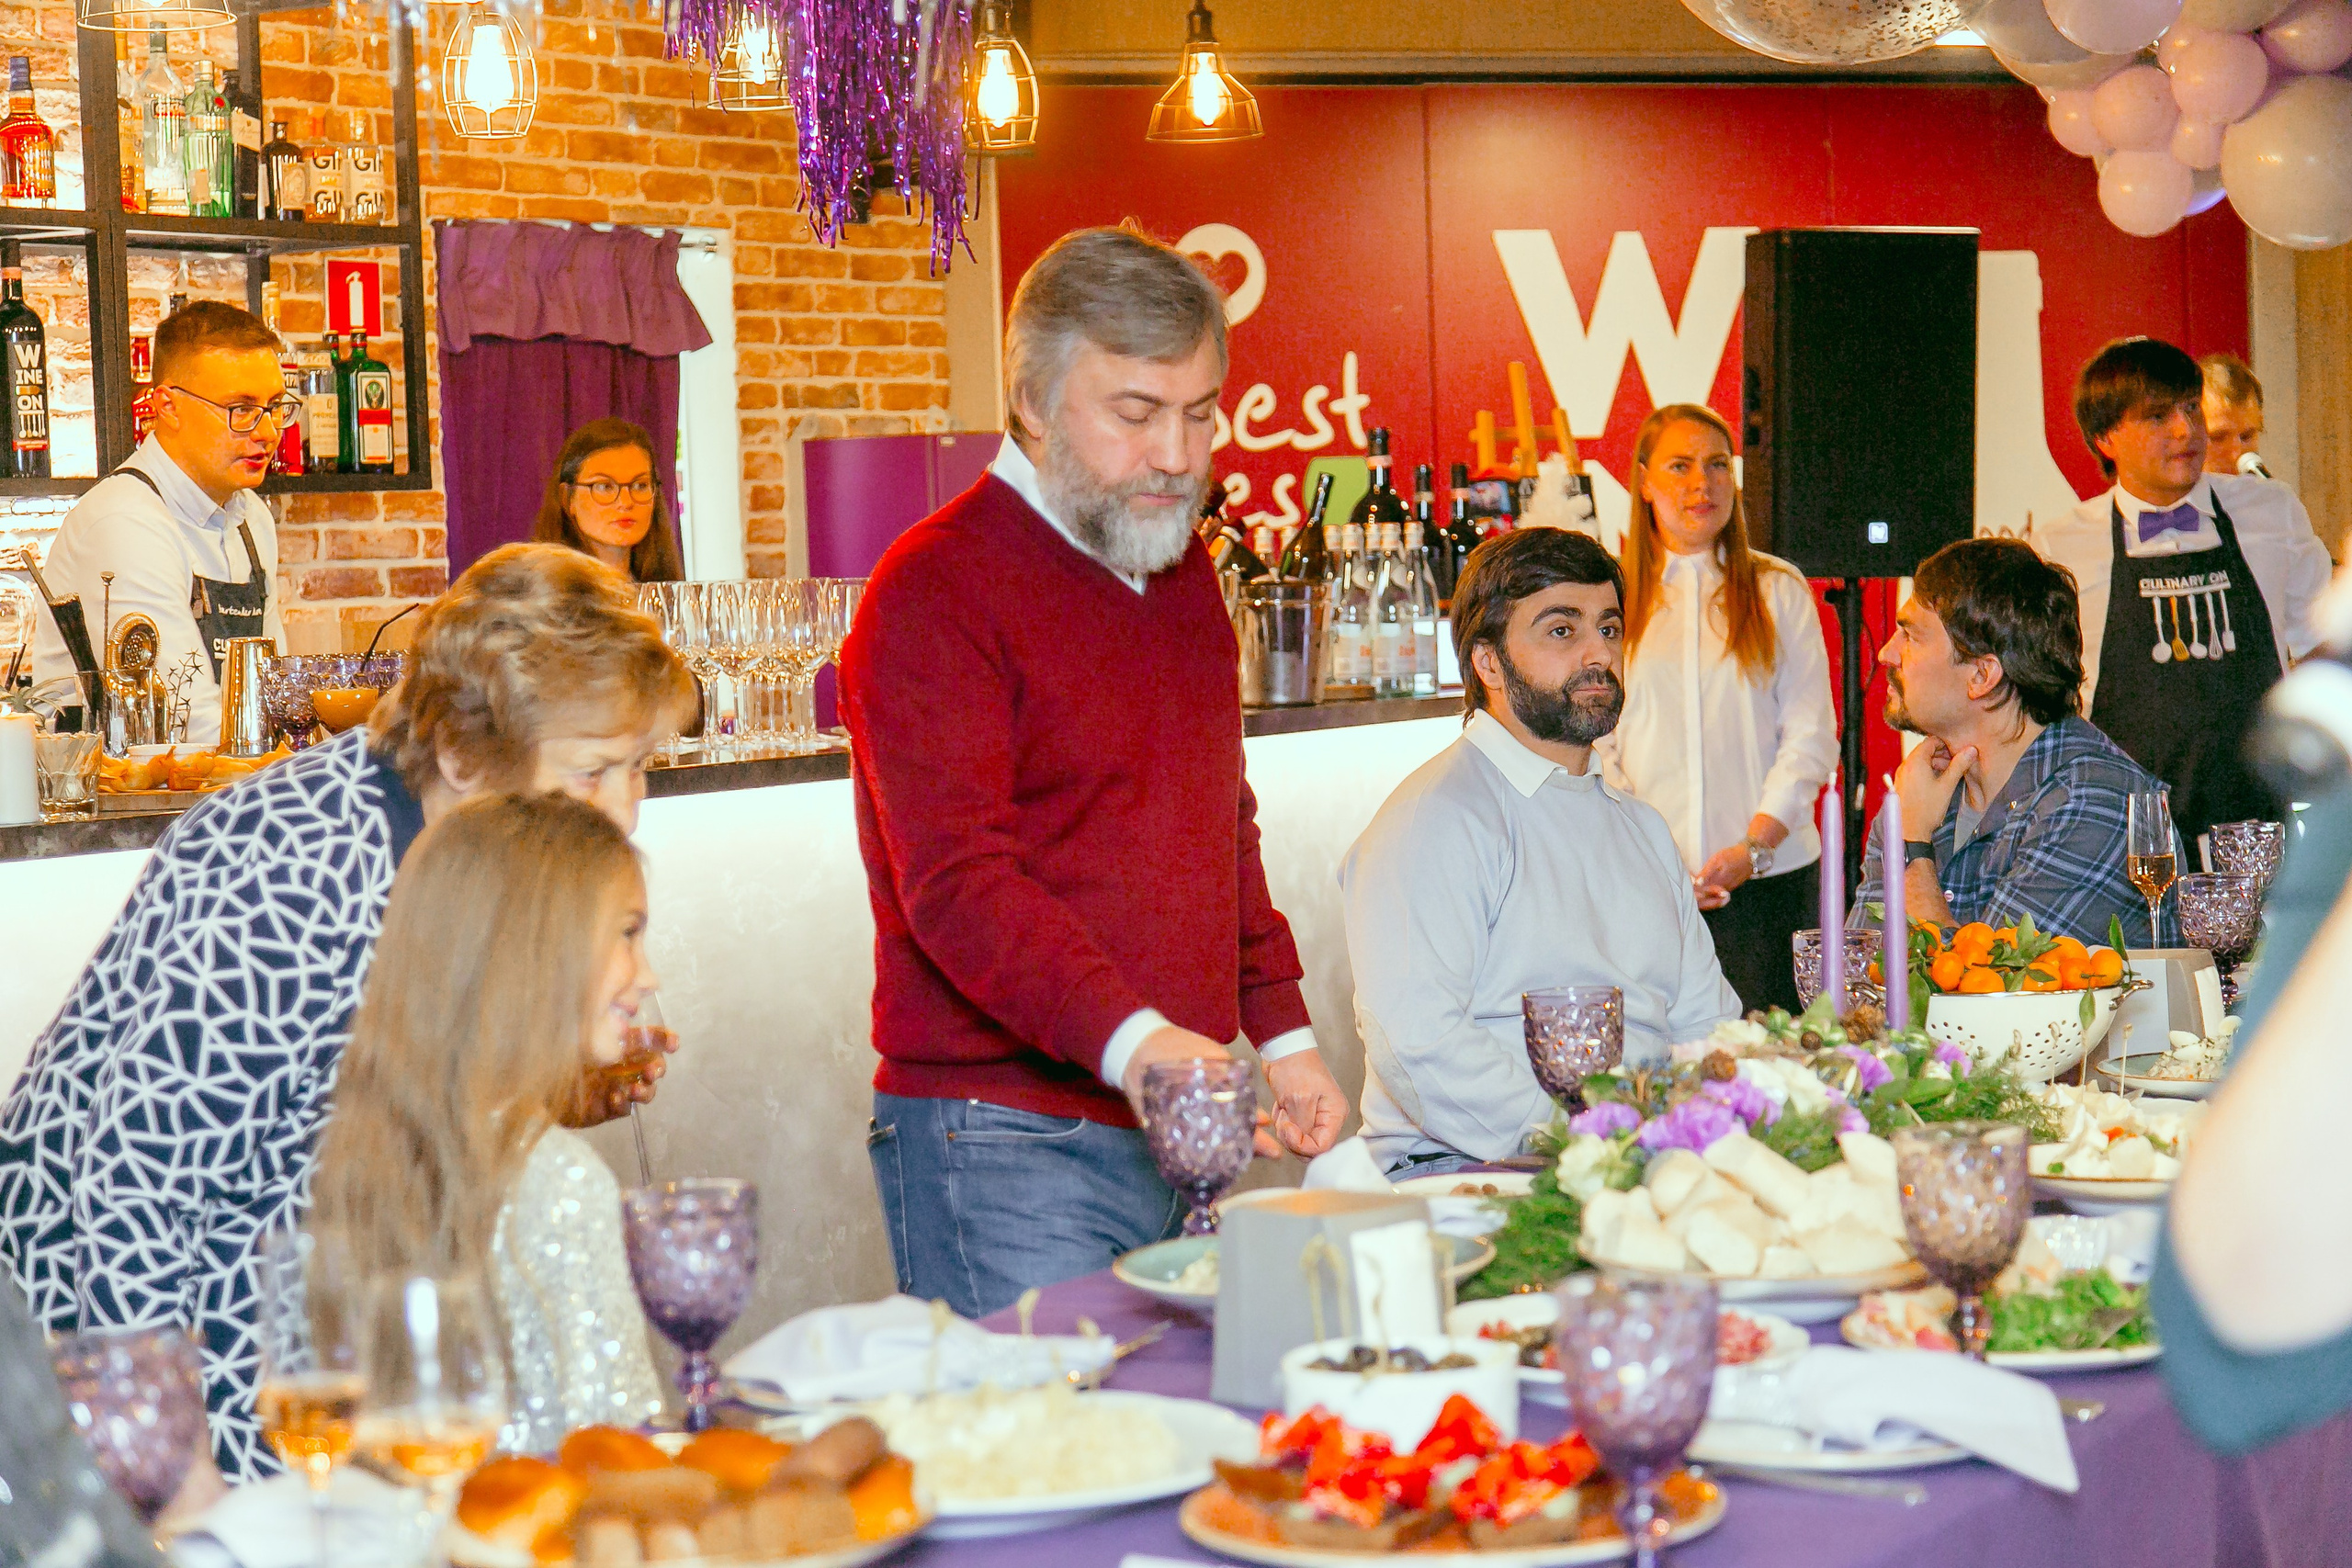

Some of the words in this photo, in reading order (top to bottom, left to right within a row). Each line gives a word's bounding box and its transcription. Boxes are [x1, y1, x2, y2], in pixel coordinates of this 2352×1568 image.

[1491, 228, 1759, 439] W
[17, 395, 43, 411] ON
[2139, 573, 2205, 590] CULINARY
[2209, 570, 2228, 583] ON
